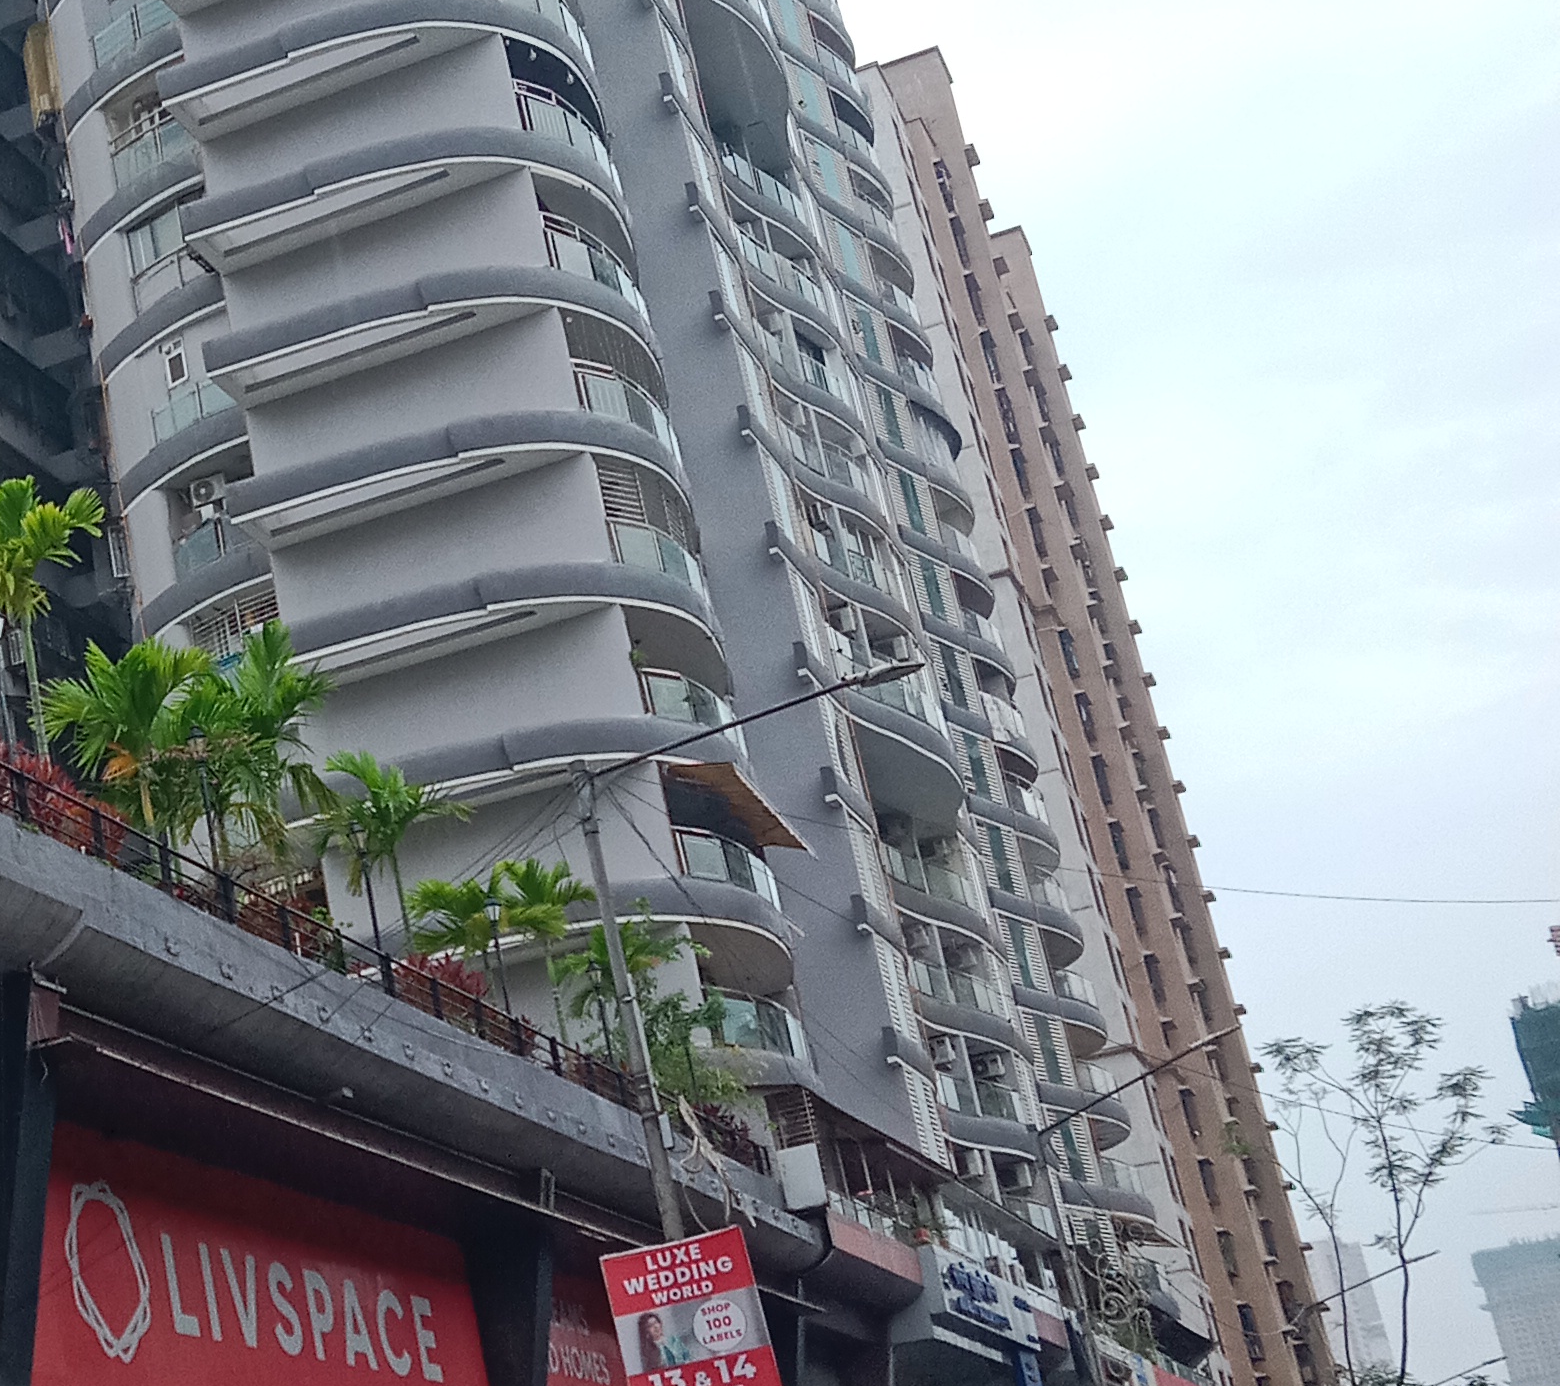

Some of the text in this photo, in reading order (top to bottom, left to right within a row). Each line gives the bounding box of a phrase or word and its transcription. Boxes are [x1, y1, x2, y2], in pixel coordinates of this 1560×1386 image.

[645, 1243, 702, 1271] LUXE
[623, 1256, 733, 1295] WEDDING
[651, 1280, 713, 1305] WORLD
[160, 1232, 443, 1382] LIVSPACE
[700, 1302, 731, 1317] SHOP
[702, 1329, 743, 1345] LABELS
[706, 1315, 732, 1331] 100
[560, 1344, 611, 1386] HOMES
[713, 1353, 757, 1385] 14
